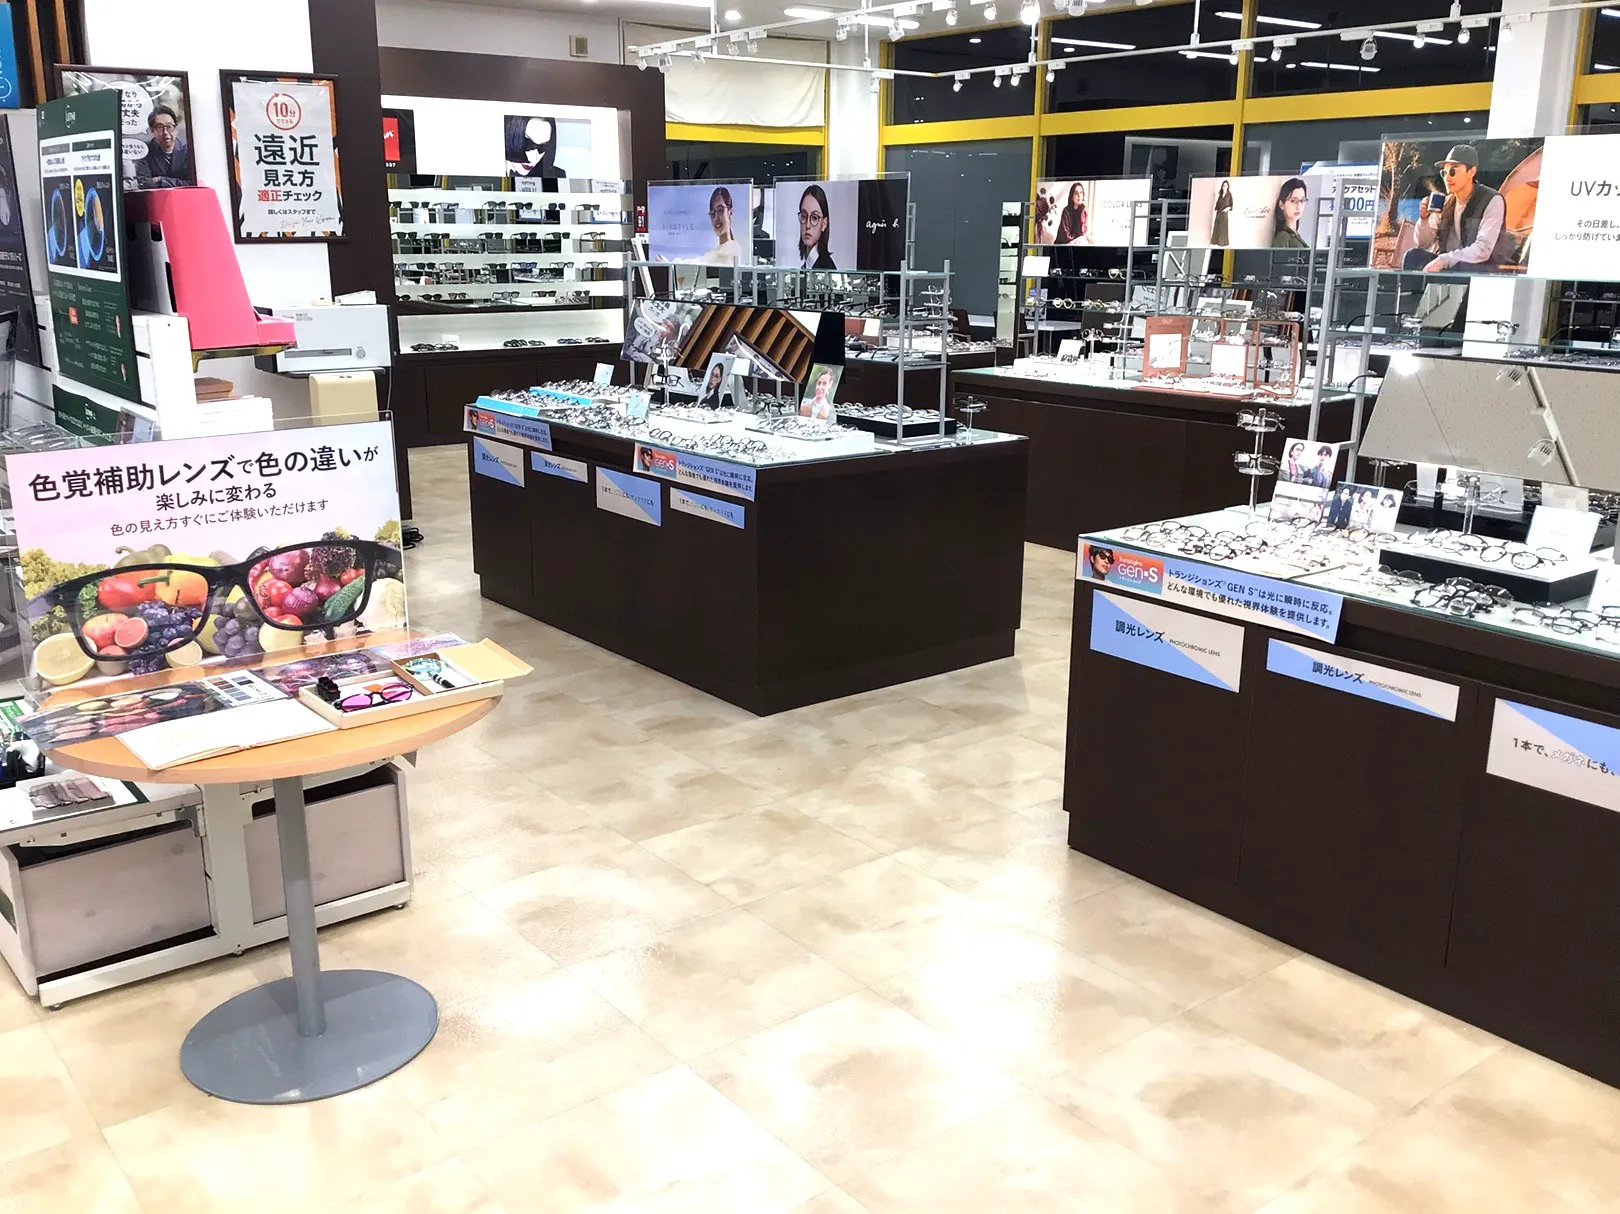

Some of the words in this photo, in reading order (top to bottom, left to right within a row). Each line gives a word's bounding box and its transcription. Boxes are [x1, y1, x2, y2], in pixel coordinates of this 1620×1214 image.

[122, 109, 140, 118] 丈夫
[273, 102, 296, 118] 10分
[254, 133, 320, 166] 遠近
[264, 169, 315, 188] 見え方
[257, 189, 322, 202] 適正チェック
[28, 445, 378, 502] 色覚補助レンズで色の違いが
[156, 482, 277, 511] 楽しみに変わる
[110, 498, 329, 537] 色の見え方すぐにご体験いただけます
[1115, 619, 1165, 644] 調光レンズ
[1312, 661, 1364, 684] 調光レンズ
